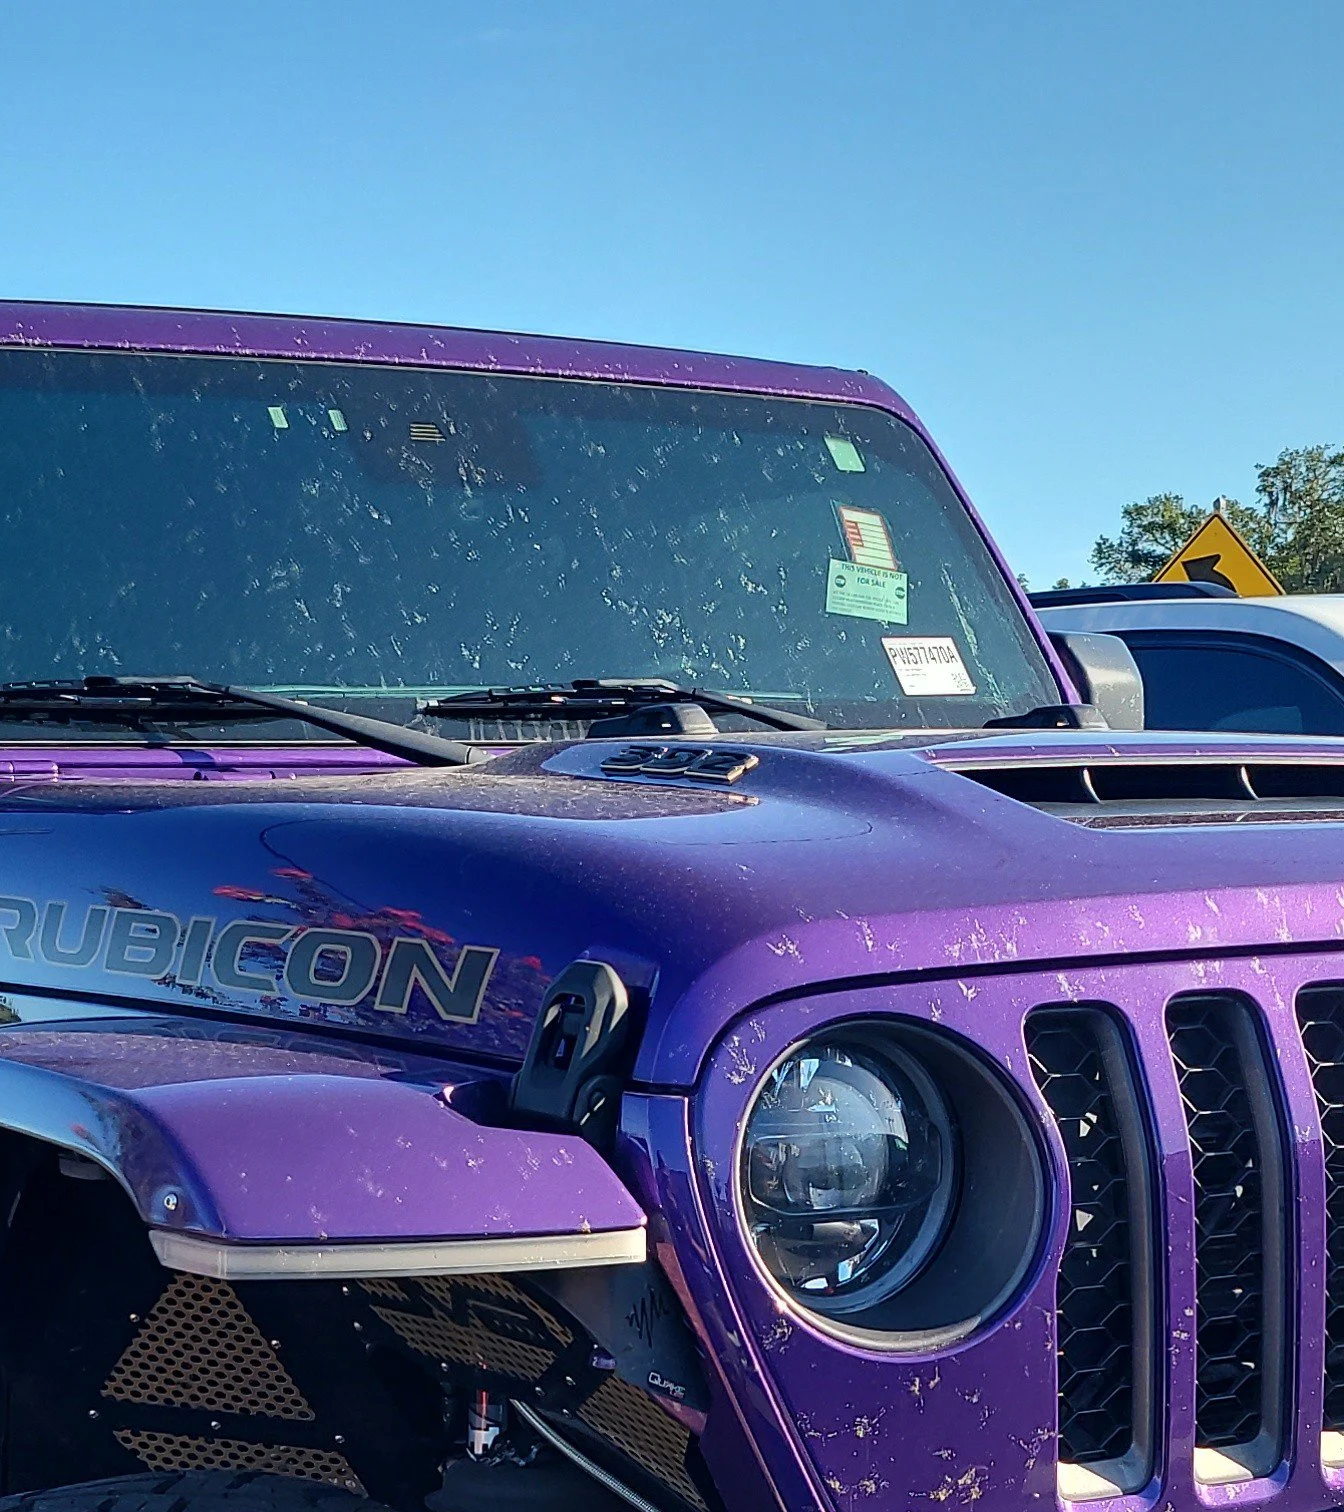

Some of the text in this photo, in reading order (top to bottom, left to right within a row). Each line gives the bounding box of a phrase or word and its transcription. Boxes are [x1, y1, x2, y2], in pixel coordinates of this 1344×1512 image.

[889, 573, 903, 581] NOT
[857, 577, 886, 588] FOR SALE
